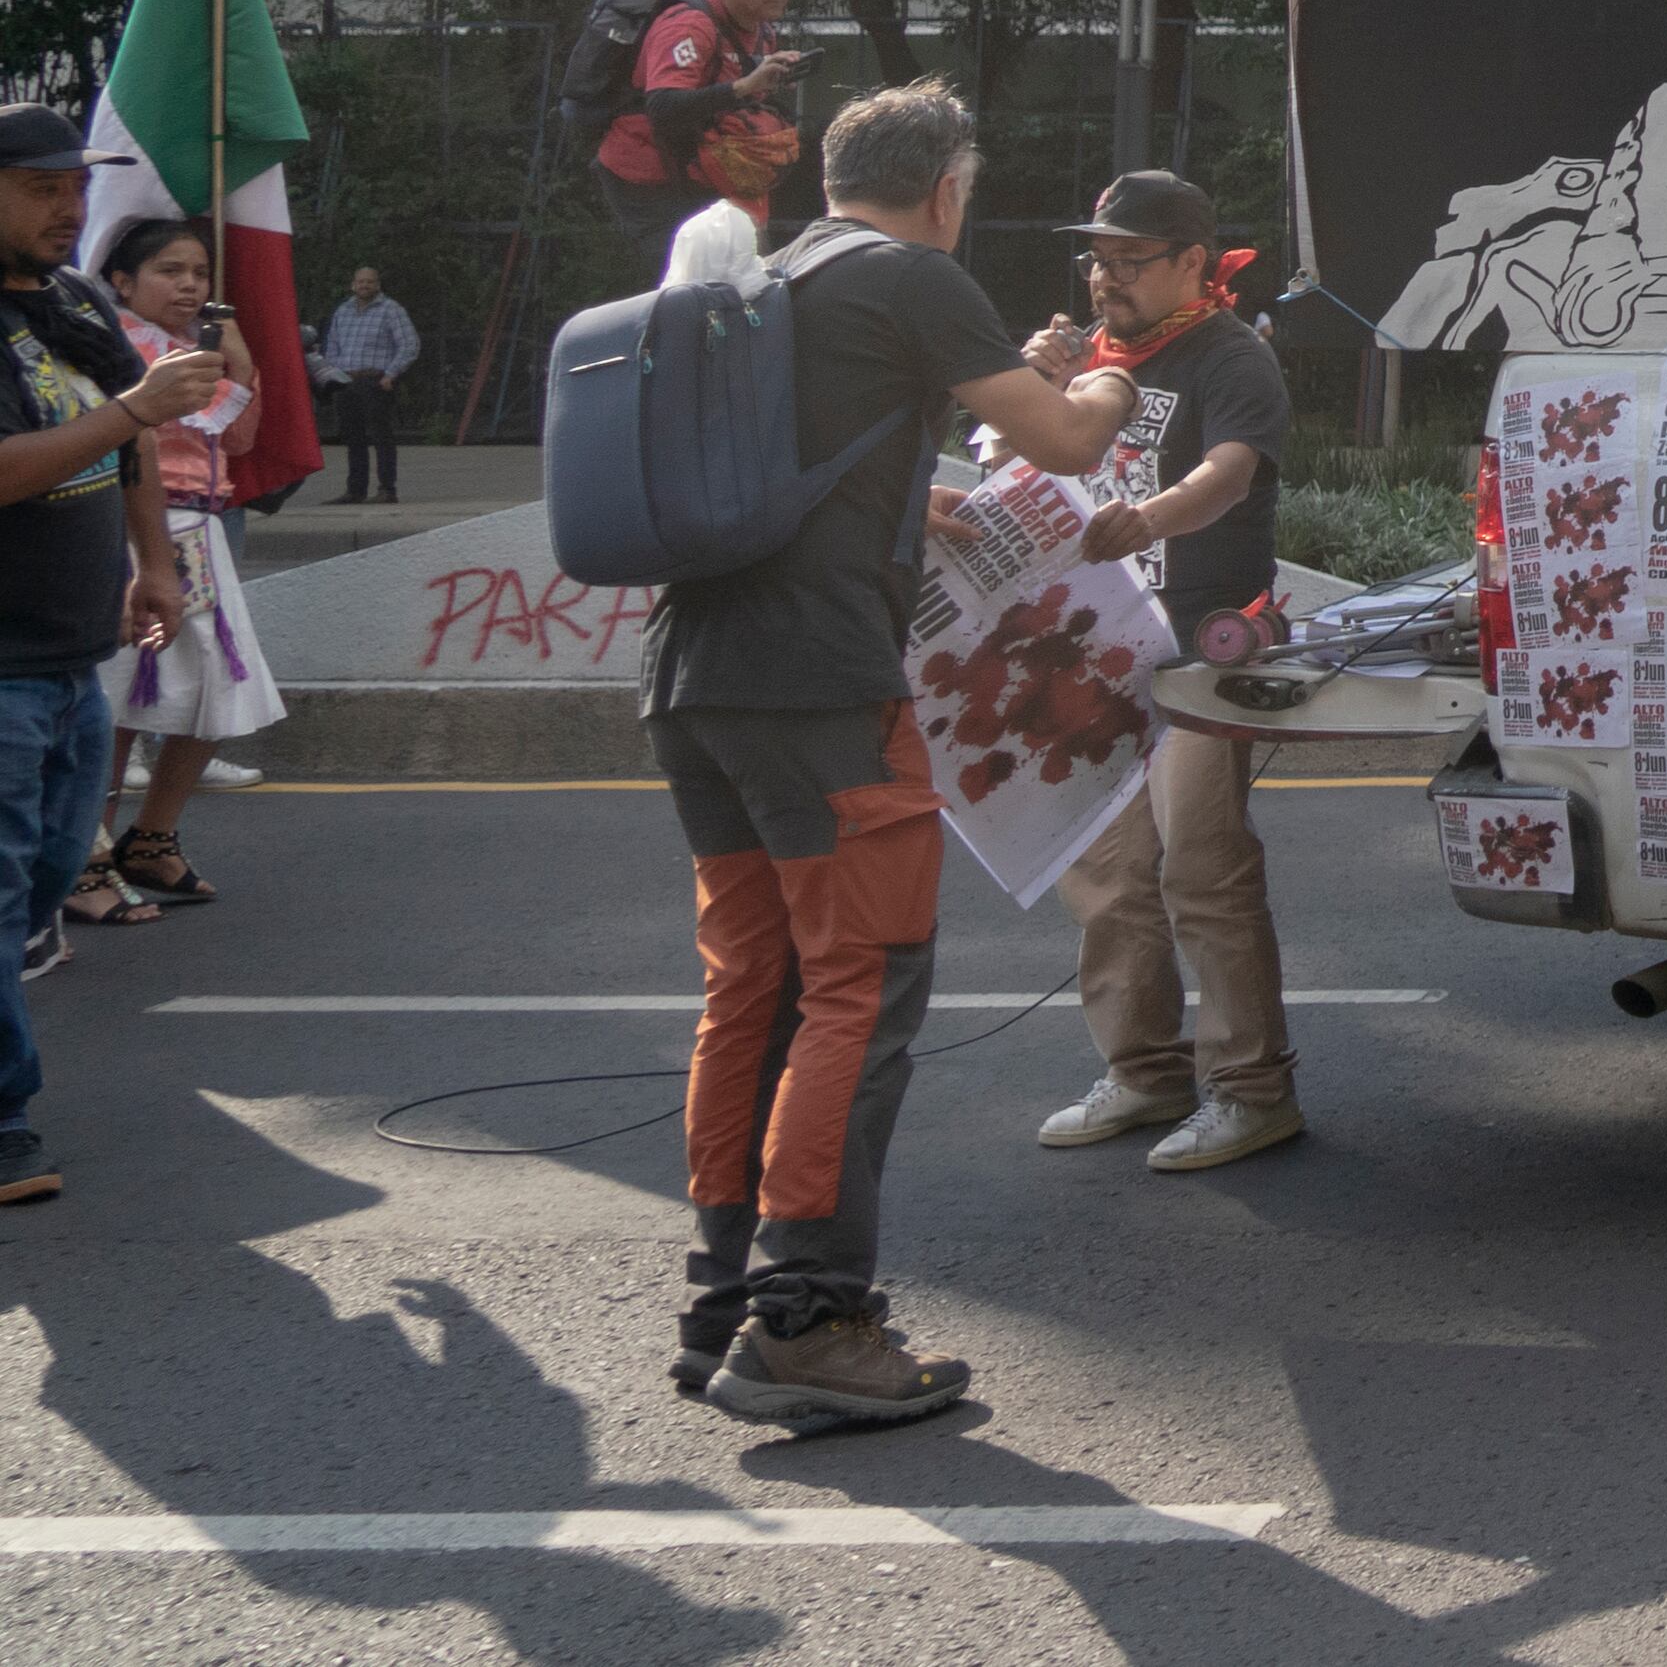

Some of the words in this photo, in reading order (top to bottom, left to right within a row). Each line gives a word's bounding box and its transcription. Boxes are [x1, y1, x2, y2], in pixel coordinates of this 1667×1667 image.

[1504, 476, 1533, 491] ALTO
[1009, 463, 1084, 540] ALTO
[975, 491, 1035, 559] contra
[1000, 486, 1061, 554] guerra
[1512, 561, 1541, 575] ALTO
[1501, 652, 1529, 663] ALTO
[1633, 704, 1665, 715] ALTO
